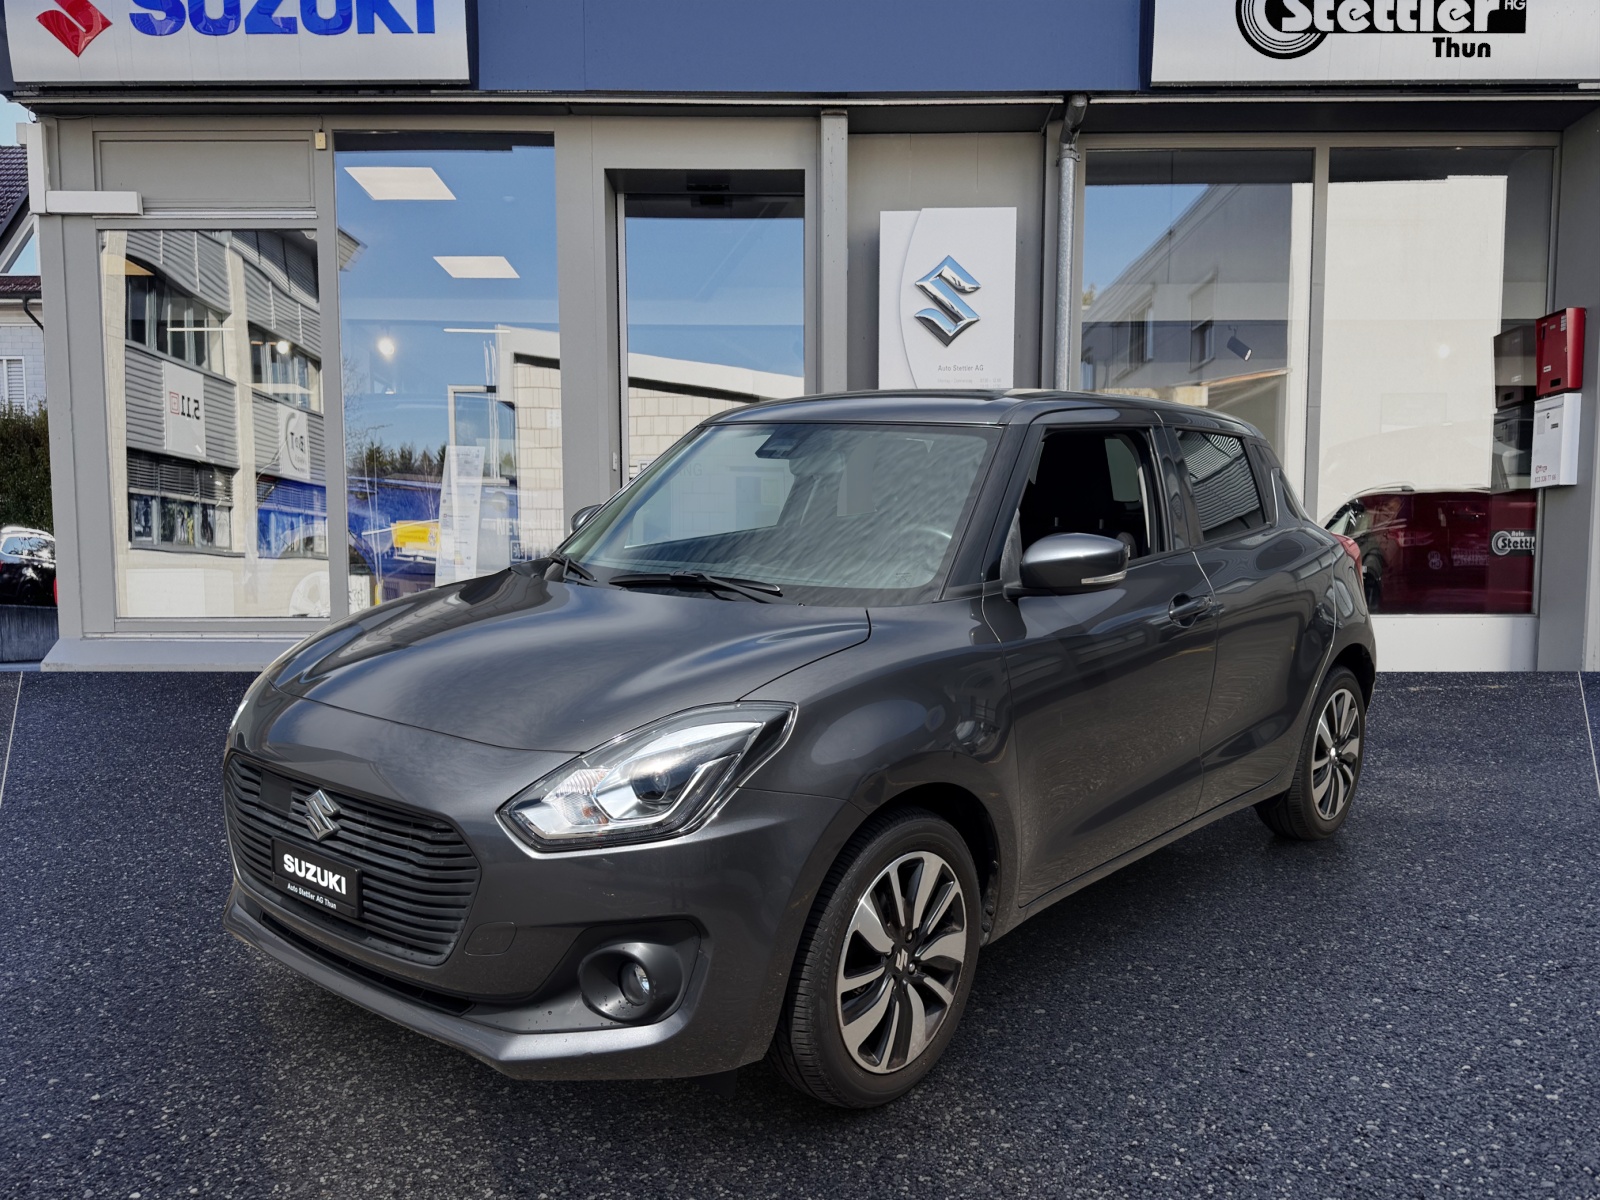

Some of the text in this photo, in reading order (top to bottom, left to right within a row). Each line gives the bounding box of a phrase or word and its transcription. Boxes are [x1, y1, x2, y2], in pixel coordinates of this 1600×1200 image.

[129, 0, 436, 36] SUZUKI
[1281, 0, 1526, 33] Stettler AG
[1432, 37, 1491, 58] Thun
[1501, 537, 1535, 549] Stettl
[283, 853, 347, 895] SUZUKI
[287, 882, 337, 910] Auto Stettler AG Thun
